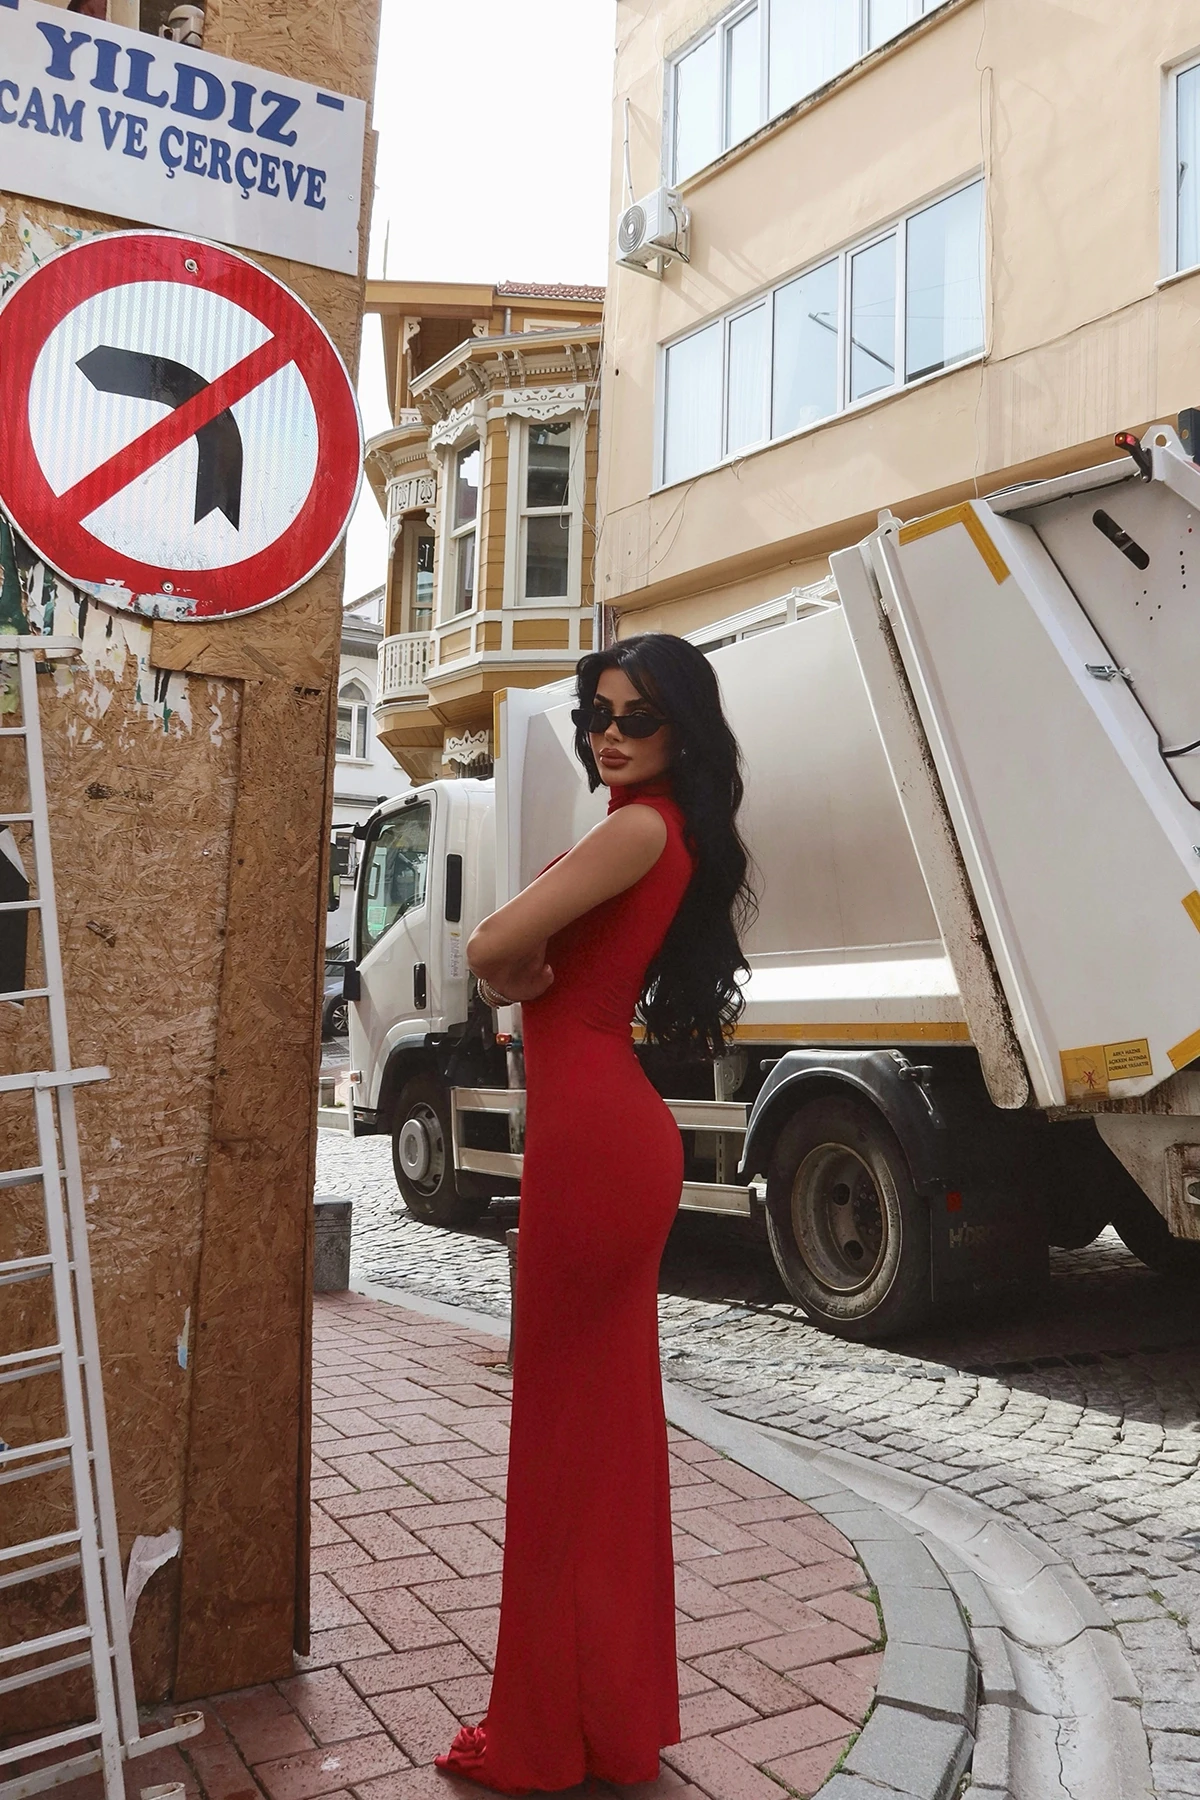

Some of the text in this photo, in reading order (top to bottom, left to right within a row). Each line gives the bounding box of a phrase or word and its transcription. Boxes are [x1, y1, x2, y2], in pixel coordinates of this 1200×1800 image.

[0, 79, 326, 211] CAM VE ÇERÇEVE
[36, 21, 301, 147] YILDIZ
